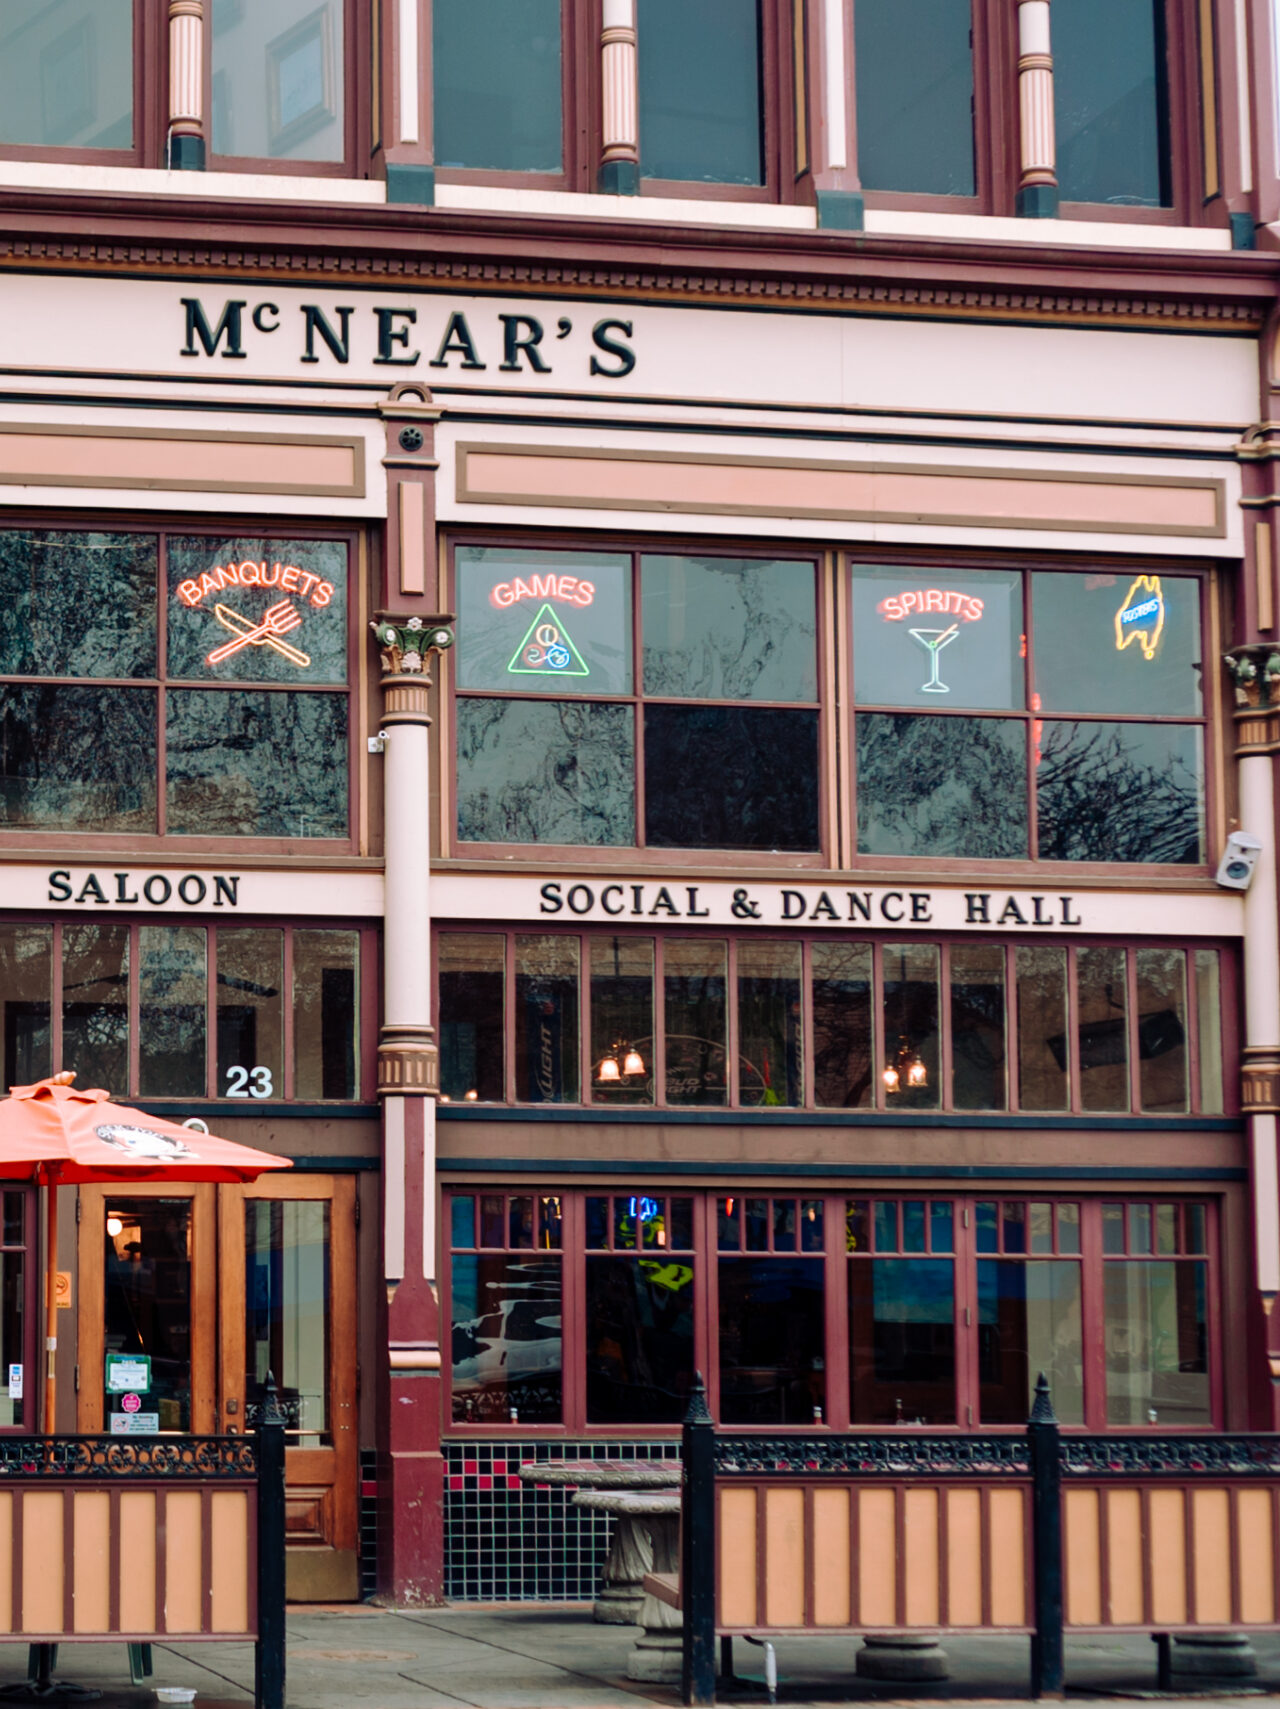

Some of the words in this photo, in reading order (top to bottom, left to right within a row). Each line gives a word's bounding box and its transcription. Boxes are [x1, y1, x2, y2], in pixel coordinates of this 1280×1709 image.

[178, 560, 335, 607] BANQUETS
[492, 573, 595, 606] GAMES
[882, 589, 985, 620] SPIRITS
[48, 869, 240, 907] SALOON
[538, 883, 710, 919] SOCIAL
[730, 887, 762, 921] &
[780, 889, 933, 924] DANCE
[964, 893, 1082, 927] HALL
[225, 1064, 274, 1099] 23
